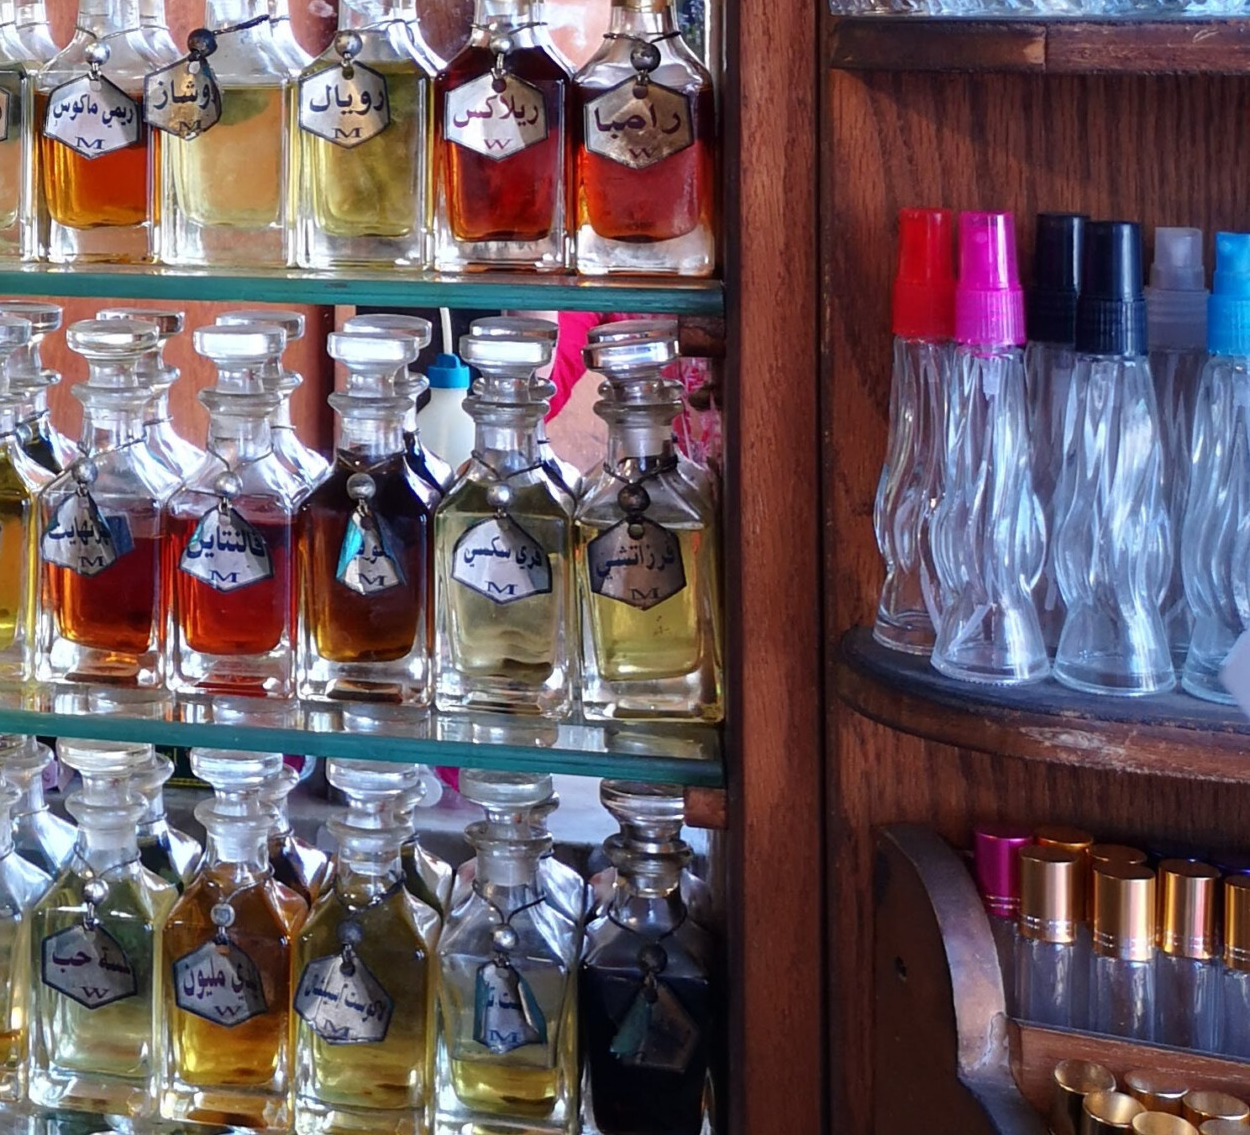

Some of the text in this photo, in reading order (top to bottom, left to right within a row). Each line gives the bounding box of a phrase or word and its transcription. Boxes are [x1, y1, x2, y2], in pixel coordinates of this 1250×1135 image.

[309, 84, 384, 116] رويال
[452, 92, 539, 127] ريلاكس
[178, 120, 202, 133] M
[331, 127, 362, 139] M
[75, 136, 106, 150] M
[483, 138, 512, 150] W
[628, 148, 657, 159] W
[80, 555, 104, 567] M
[211, 570, 241, 584] M
[358, 573, 386, 587] M
[486, 581, 519, 595] M
[630, 587, 661, 600] M
[52, 951, 92, 973] حب
[183, 956, 226, 1000] مليون
[80, 986, 111, 999] W
[214, 1006, 242, 1018] W
[322, 1018, 353, 1039] M
[488, 1030, 521, 1043] M
